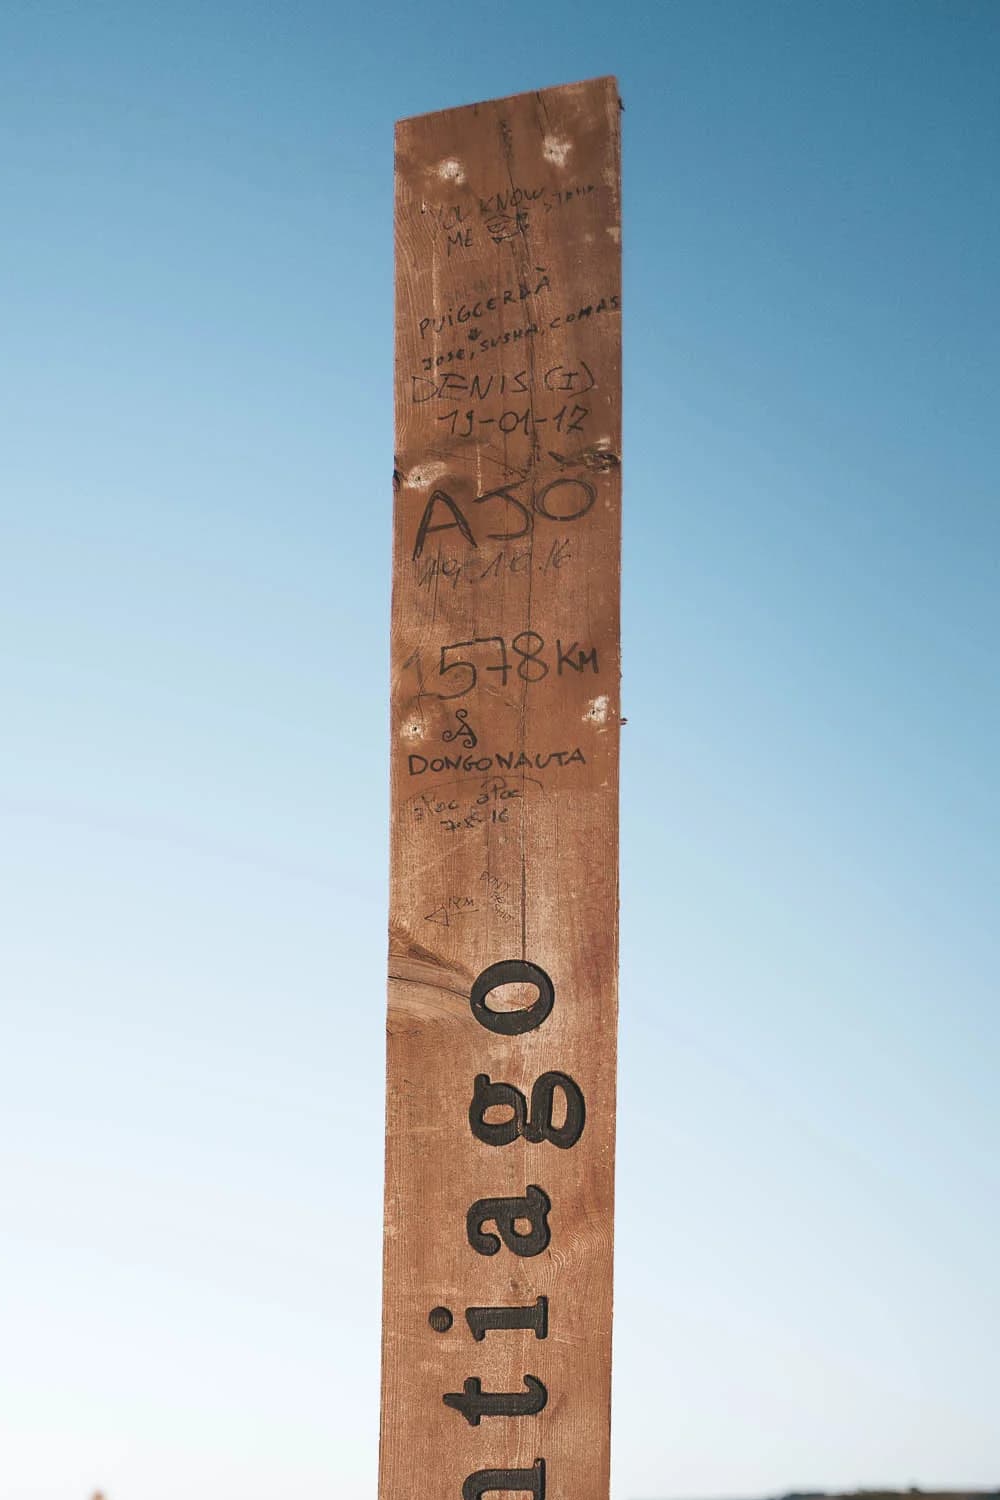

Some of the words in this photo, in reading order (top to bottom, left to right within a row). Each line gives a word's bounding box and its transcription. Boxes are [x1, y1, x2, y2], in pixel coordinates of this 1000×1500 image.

[480, 186, 545, 213] KNOW
[411, 370, 529, 403] DENIS
[407, 747, 588, 777] DONGONAUTA
